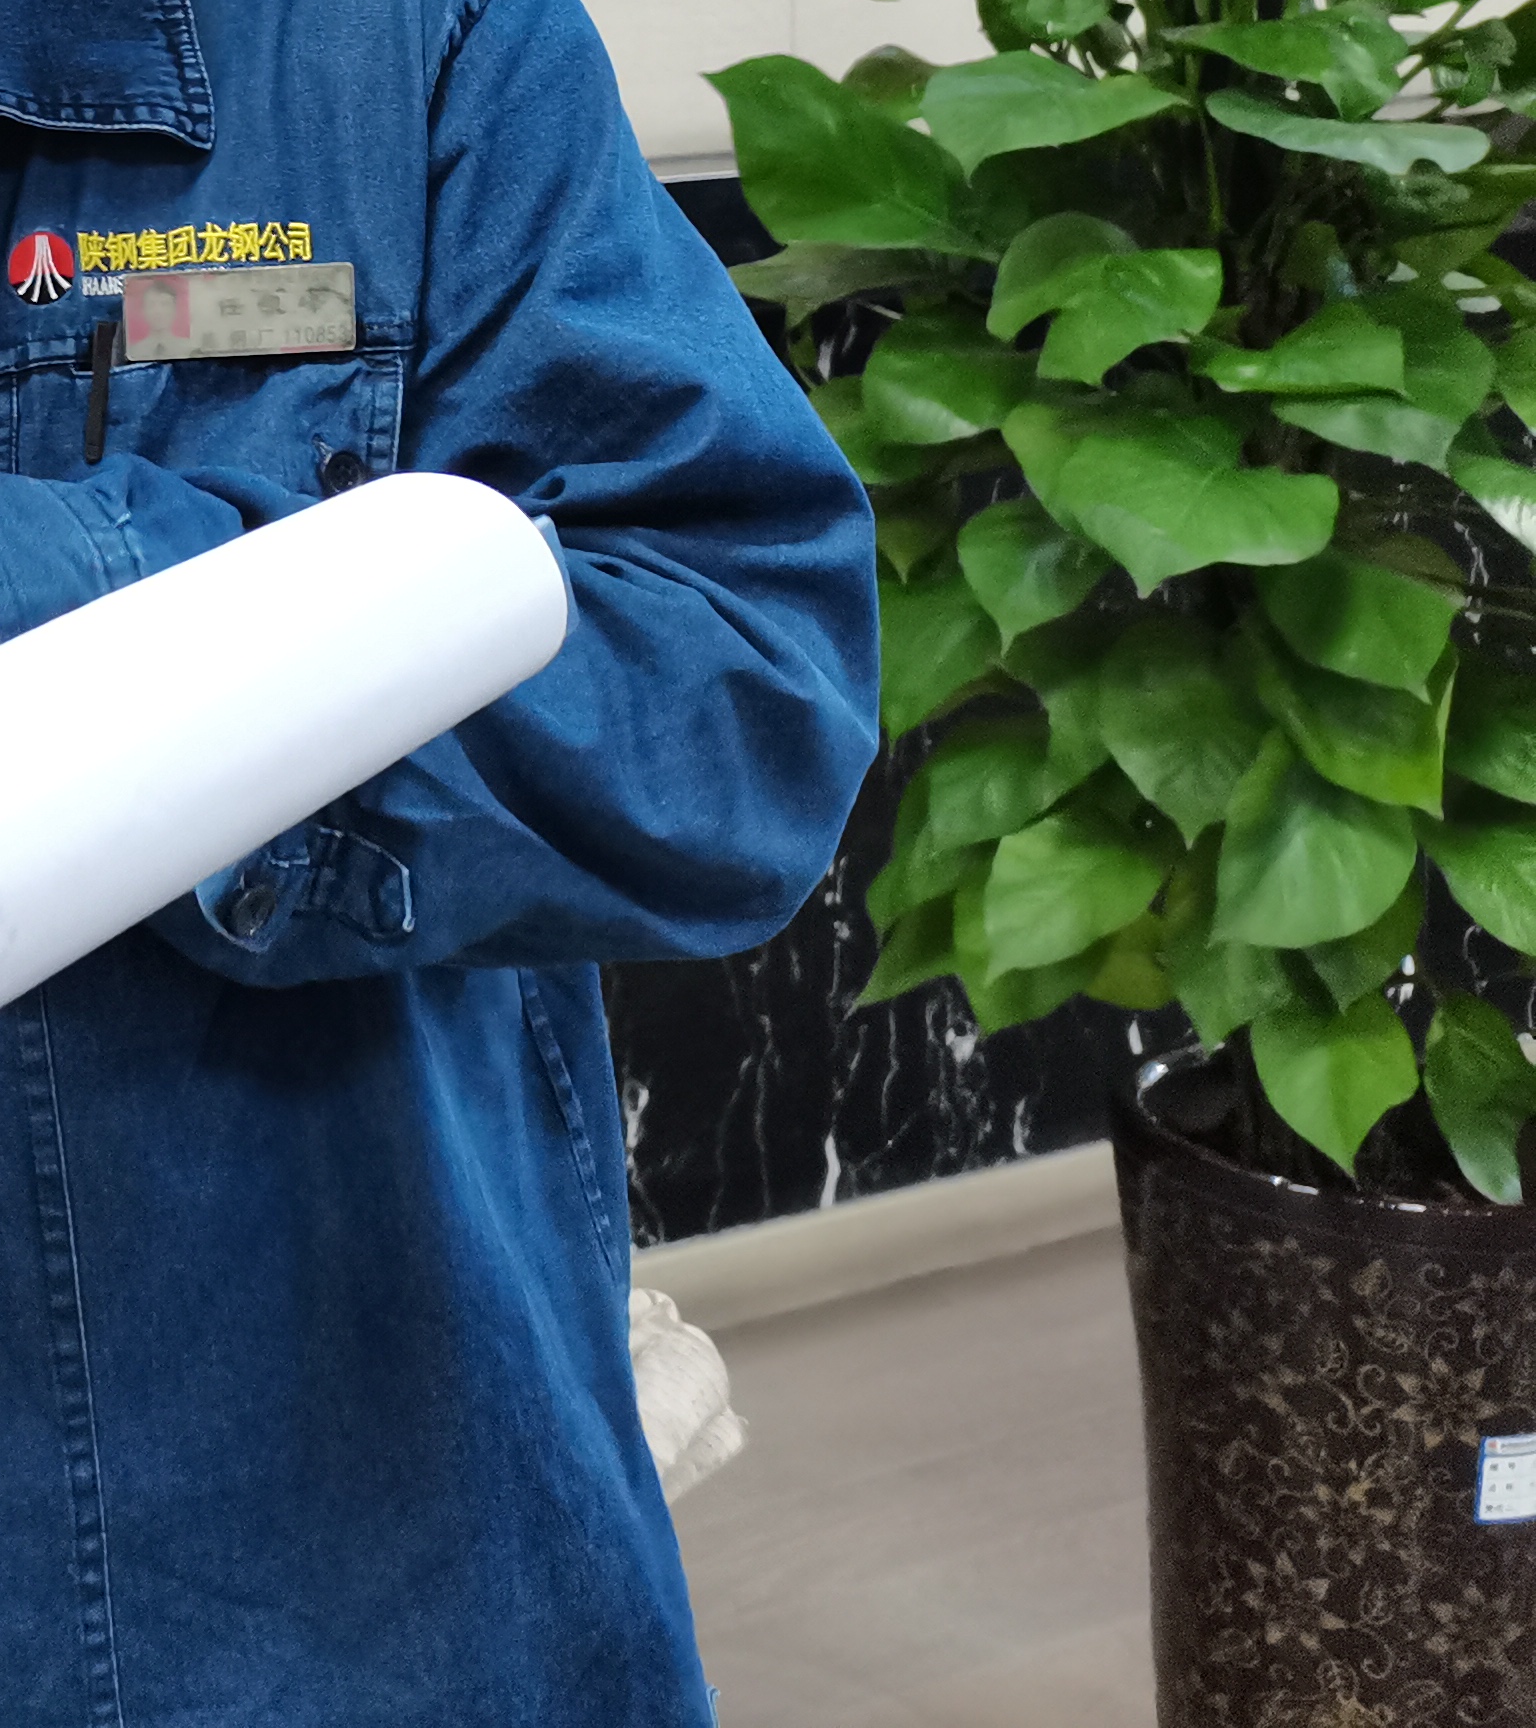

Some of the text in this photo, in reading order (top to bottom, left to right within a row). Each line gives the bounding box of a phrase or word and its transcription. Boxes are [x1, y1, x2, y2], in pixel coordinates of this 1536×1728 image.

[77, 222, 313, 271] 陕钢集团龙钢公司
